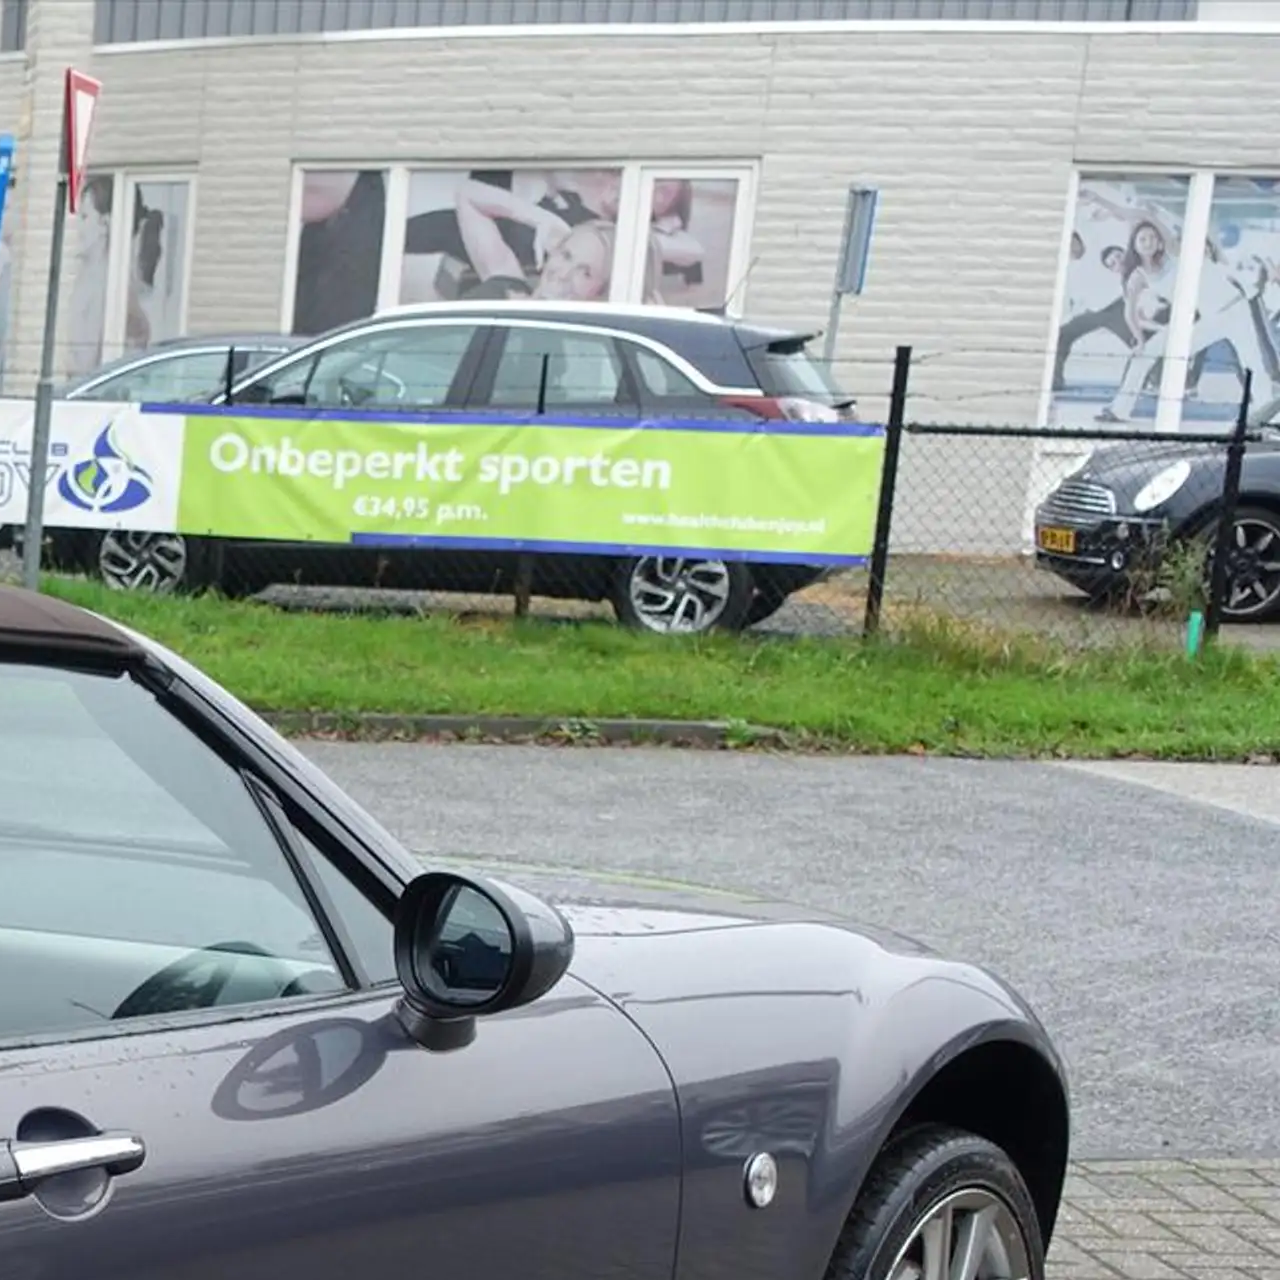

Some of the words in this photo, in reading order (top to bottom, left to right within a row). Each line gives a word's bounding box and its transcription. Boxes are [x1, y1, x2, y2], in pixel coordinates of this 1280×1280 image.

[208, 433, 464, 490] Onbeperkt
[478, 450, 672, 494] sporten
[352, 495, 429, 520] €34,95
[436, 503, 488, 525] p.m.
